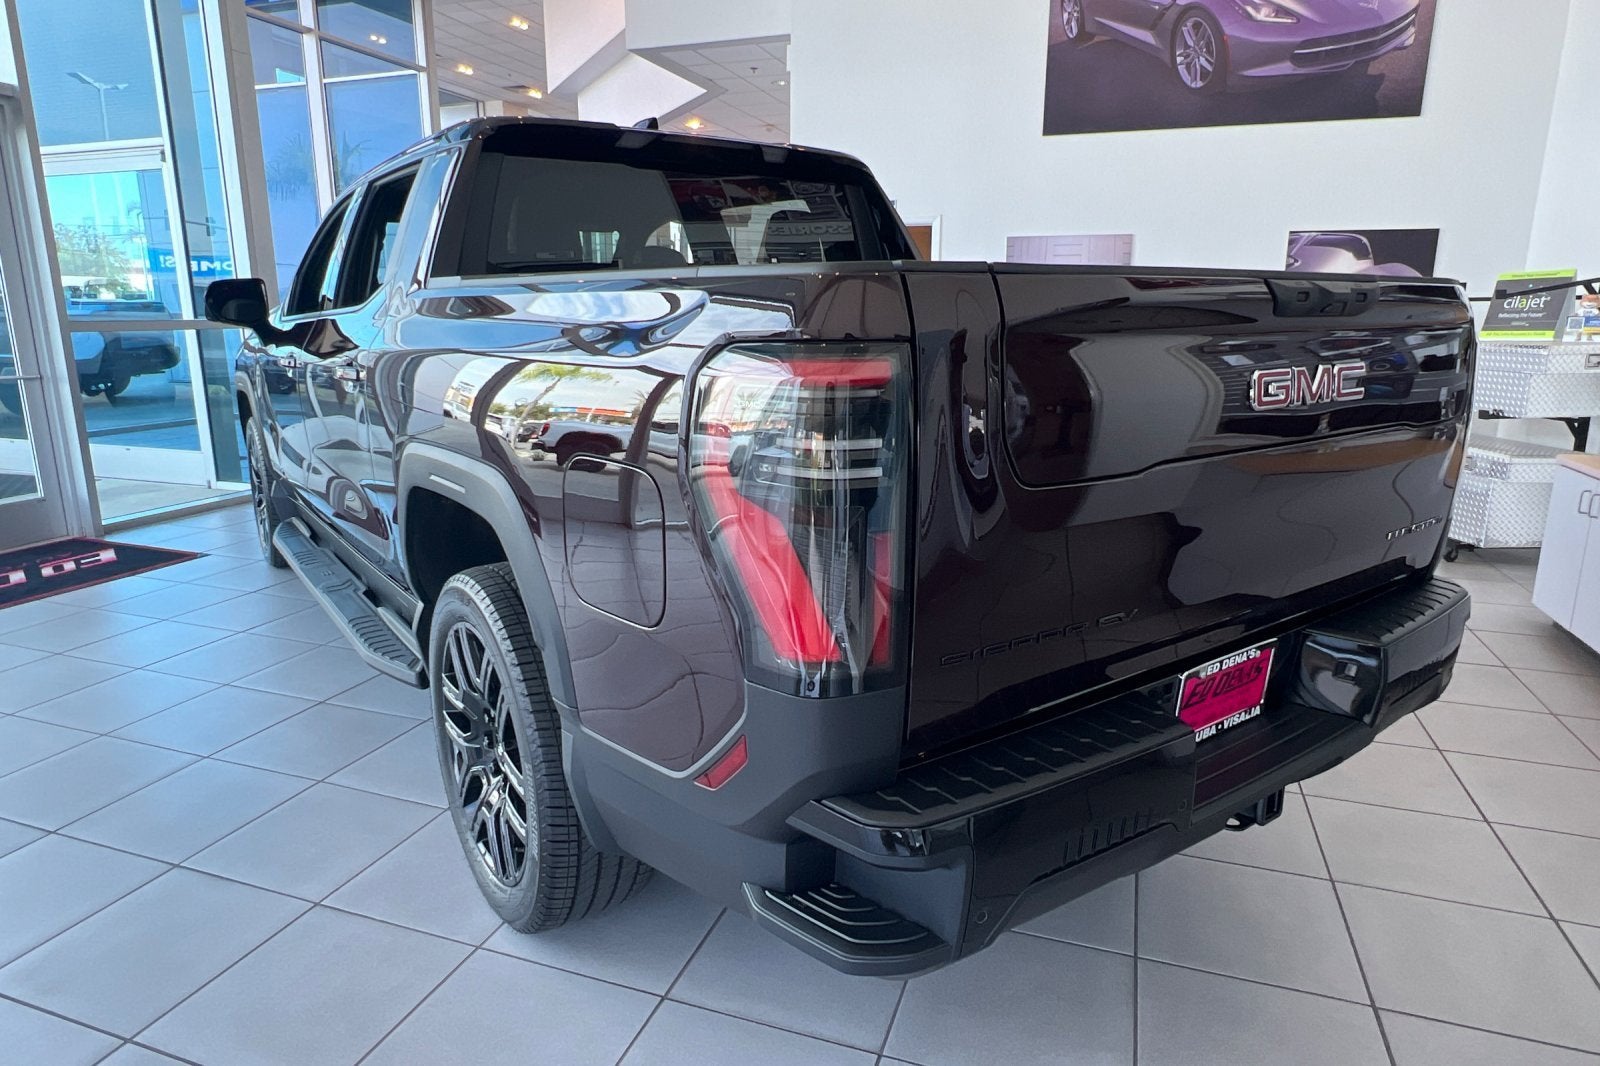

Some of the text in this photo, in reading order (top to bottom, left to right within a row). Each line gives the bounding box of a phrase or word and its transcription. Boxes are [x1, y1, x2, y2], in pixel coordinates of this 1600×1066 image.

[1503, 295, 1546, 311] cilajet
[1250, 362, 1366, 411] GMC
[1206, 648, 1257, 676] ED DENA'S
[1195, 705, 1261, 743] UBA VISALIA
